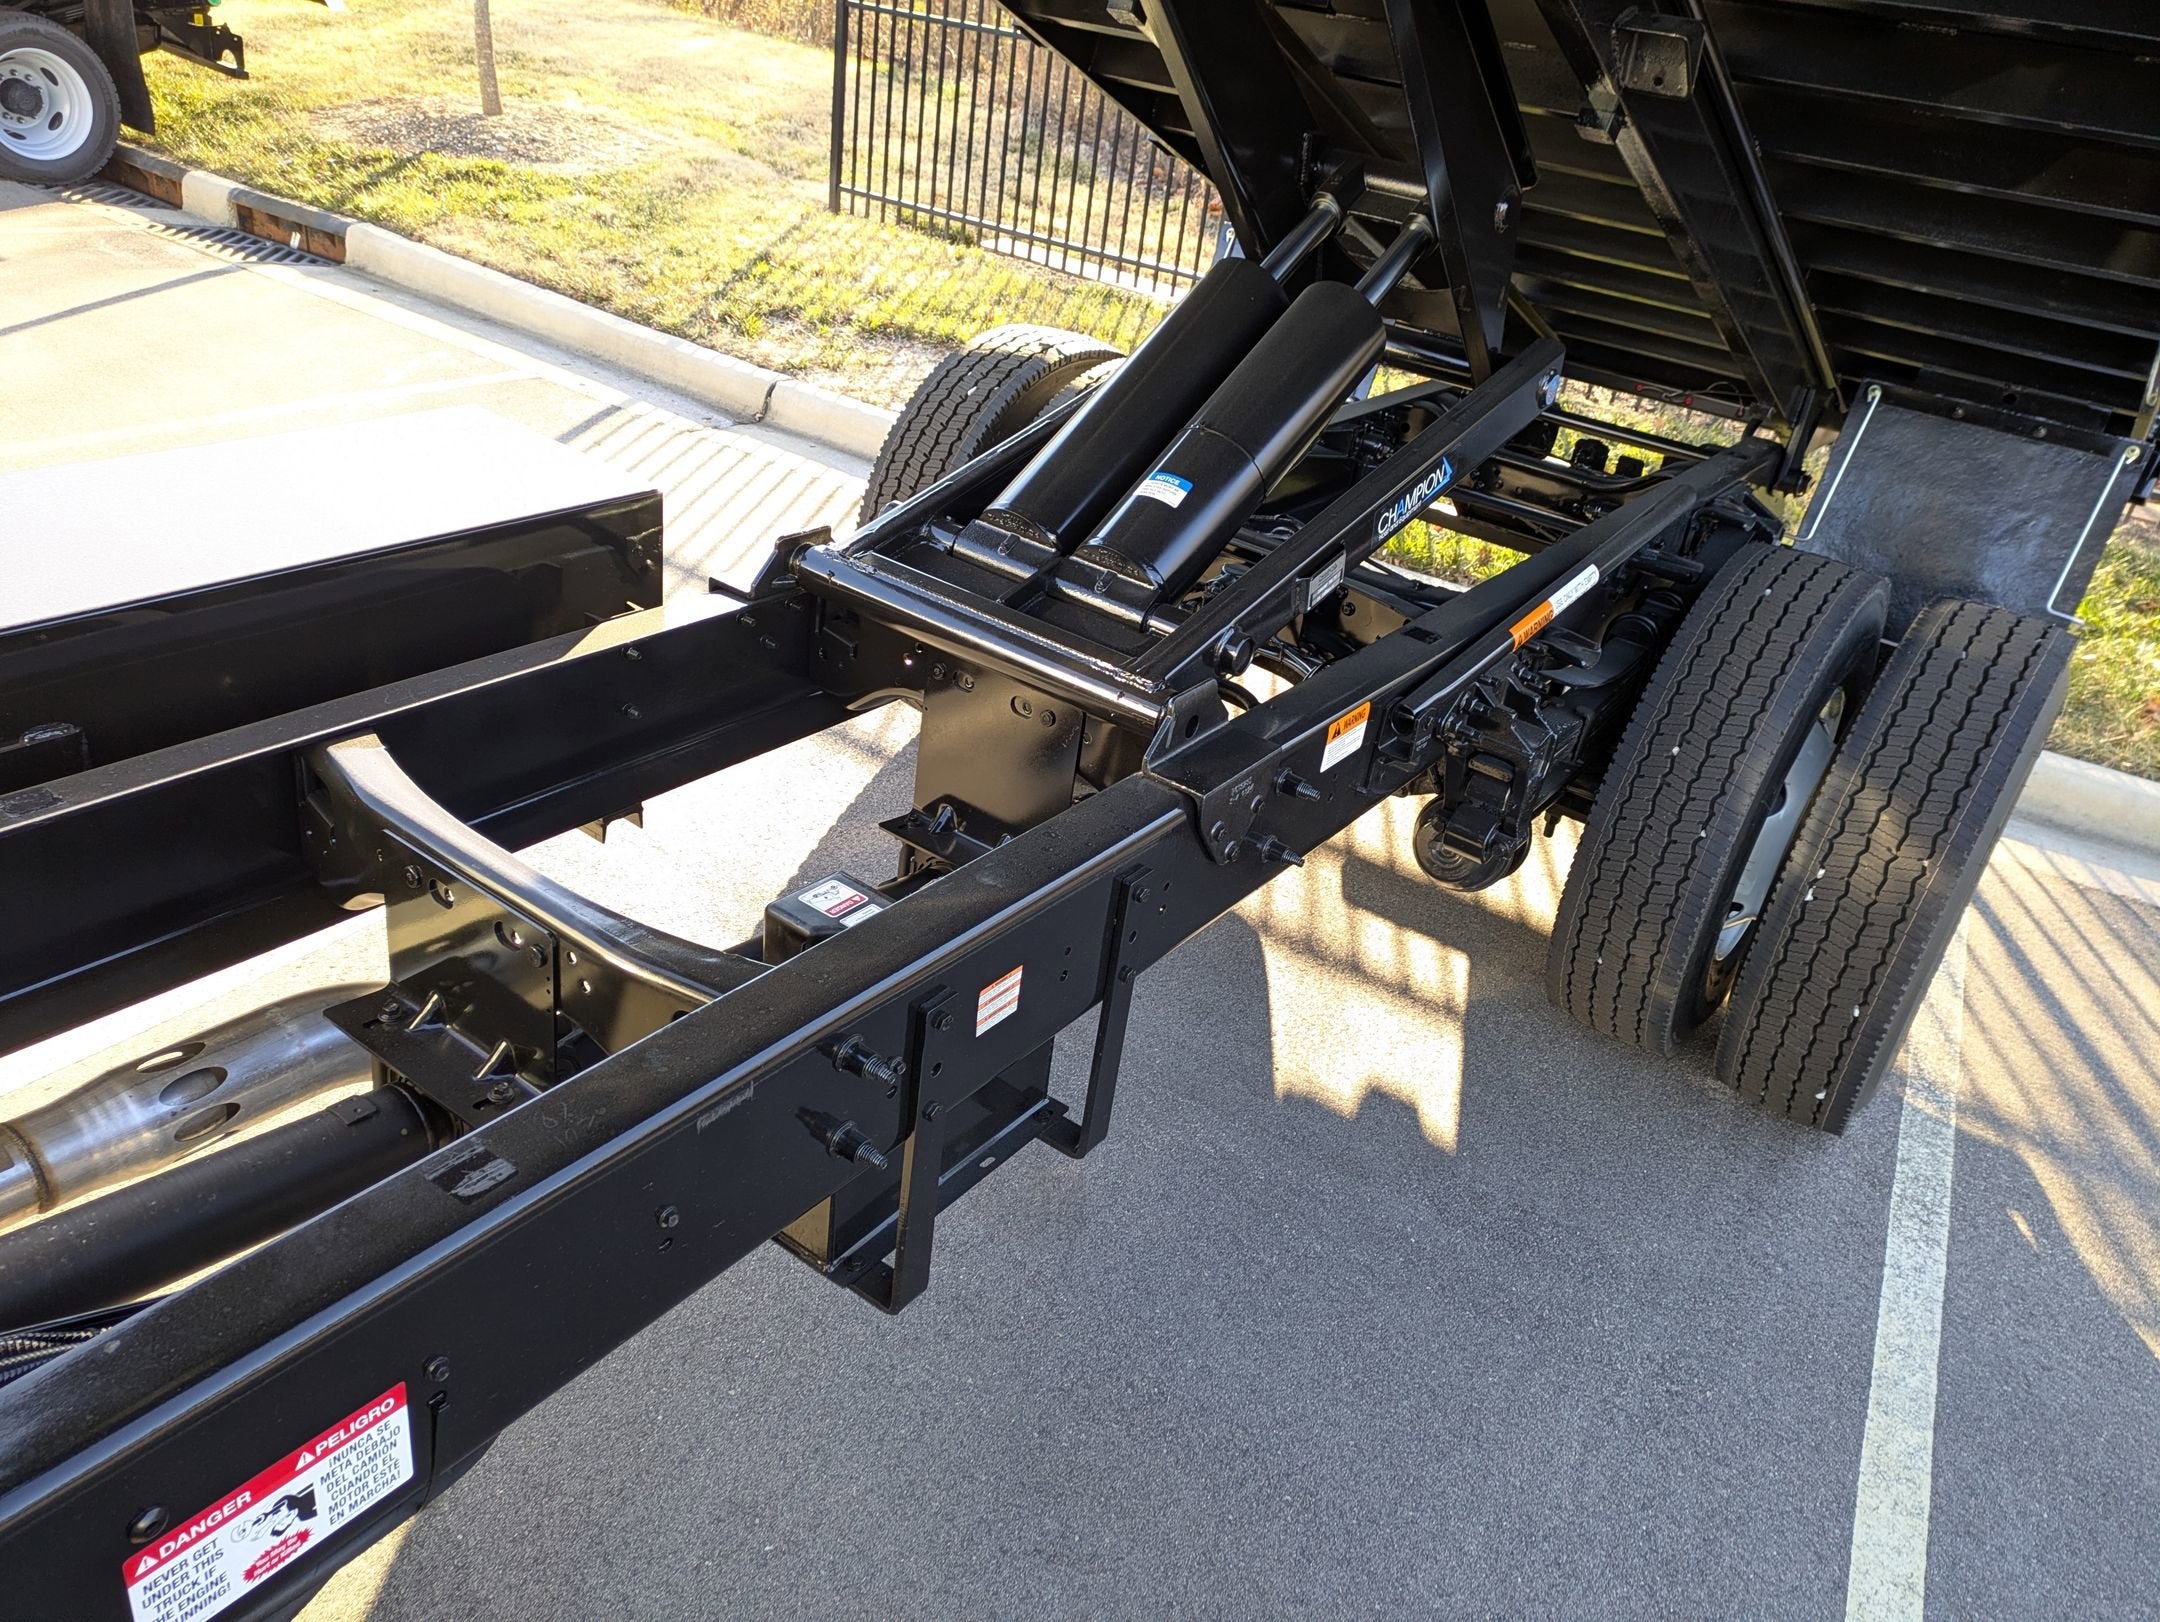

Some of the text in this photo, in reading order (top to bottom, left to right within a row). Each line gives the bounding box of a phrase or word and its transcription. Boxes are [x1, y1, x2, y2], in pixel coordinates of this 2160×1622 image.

[1155, 474, 1181, 486] NOTICE
[1378, 464, 1447, 534] CHAMPION
[1523, 609, 1554, 638] WARNING
[1343, 708, 1367, 730] WARNING
[315, 1397, 396, 1457] PELIGRO
[377, 1420, 392, 1436] SE
[320, 1425, 401, 1486] META DEBAJO
[326, 1438, 398, 1494] DEL CAMIÓN
[331, 1453, 396, 1501] CUANDO EL
[328, 1480, 370, 1515] MOTOR
[330, 1510, 345, 1526] EN
[348, 1470, 401, 1513] MARCHA!
[159, 1491, 252, 1560] DANGER
[142, 1547, 224, 1610] UNDER THIS
[143, 1537, 219, 1595] NEVER GET
[153, 1565, 217, 1614] TRUCK IF
[177, 1571, 228, 1613] ENGINE
